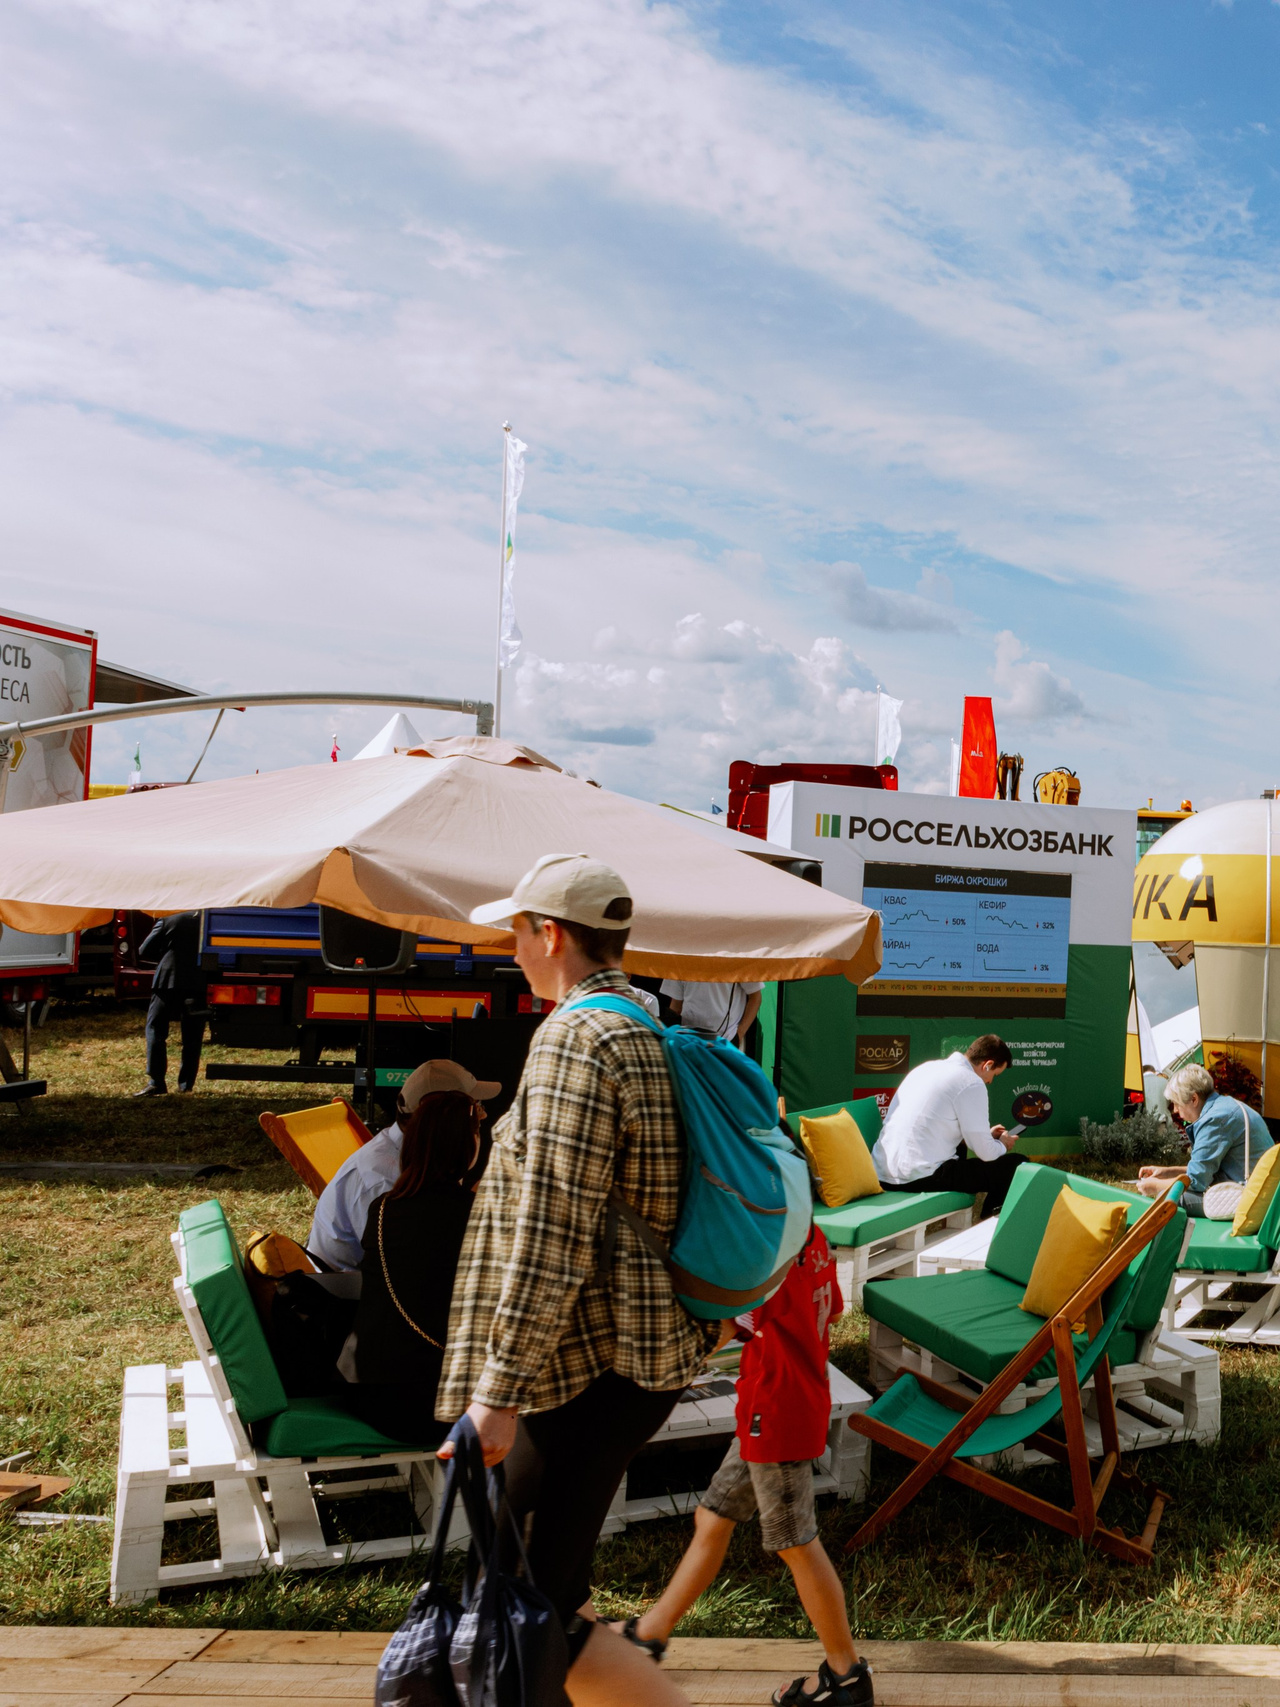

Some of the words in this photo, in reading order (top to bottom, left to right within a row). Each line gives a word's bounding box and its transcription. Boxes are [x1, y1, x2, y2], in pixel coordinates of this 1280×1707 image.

[849, 816, 1114, 857] РОССЕЛЬХОЗБАНК
[935, 873, 965, 885] БИРЖА
[966, 875, 1008, 887] ОКРОШКИ
[883, 895, 907, 906] КВАС
[979, 900, 1006, 910] КЕФИР
[952, 917, 966, 926] 50%
[1042, 921, 1055, 930] 32%
[883, 939, 911, 950] АЙРАН
[976, 943, 1000, 954] ВОДА
[950, 961, 962, 969] 15%
[1040, 964, 1050, 972] 3%
[860, 1047, 904, 1058] РОСКАР
